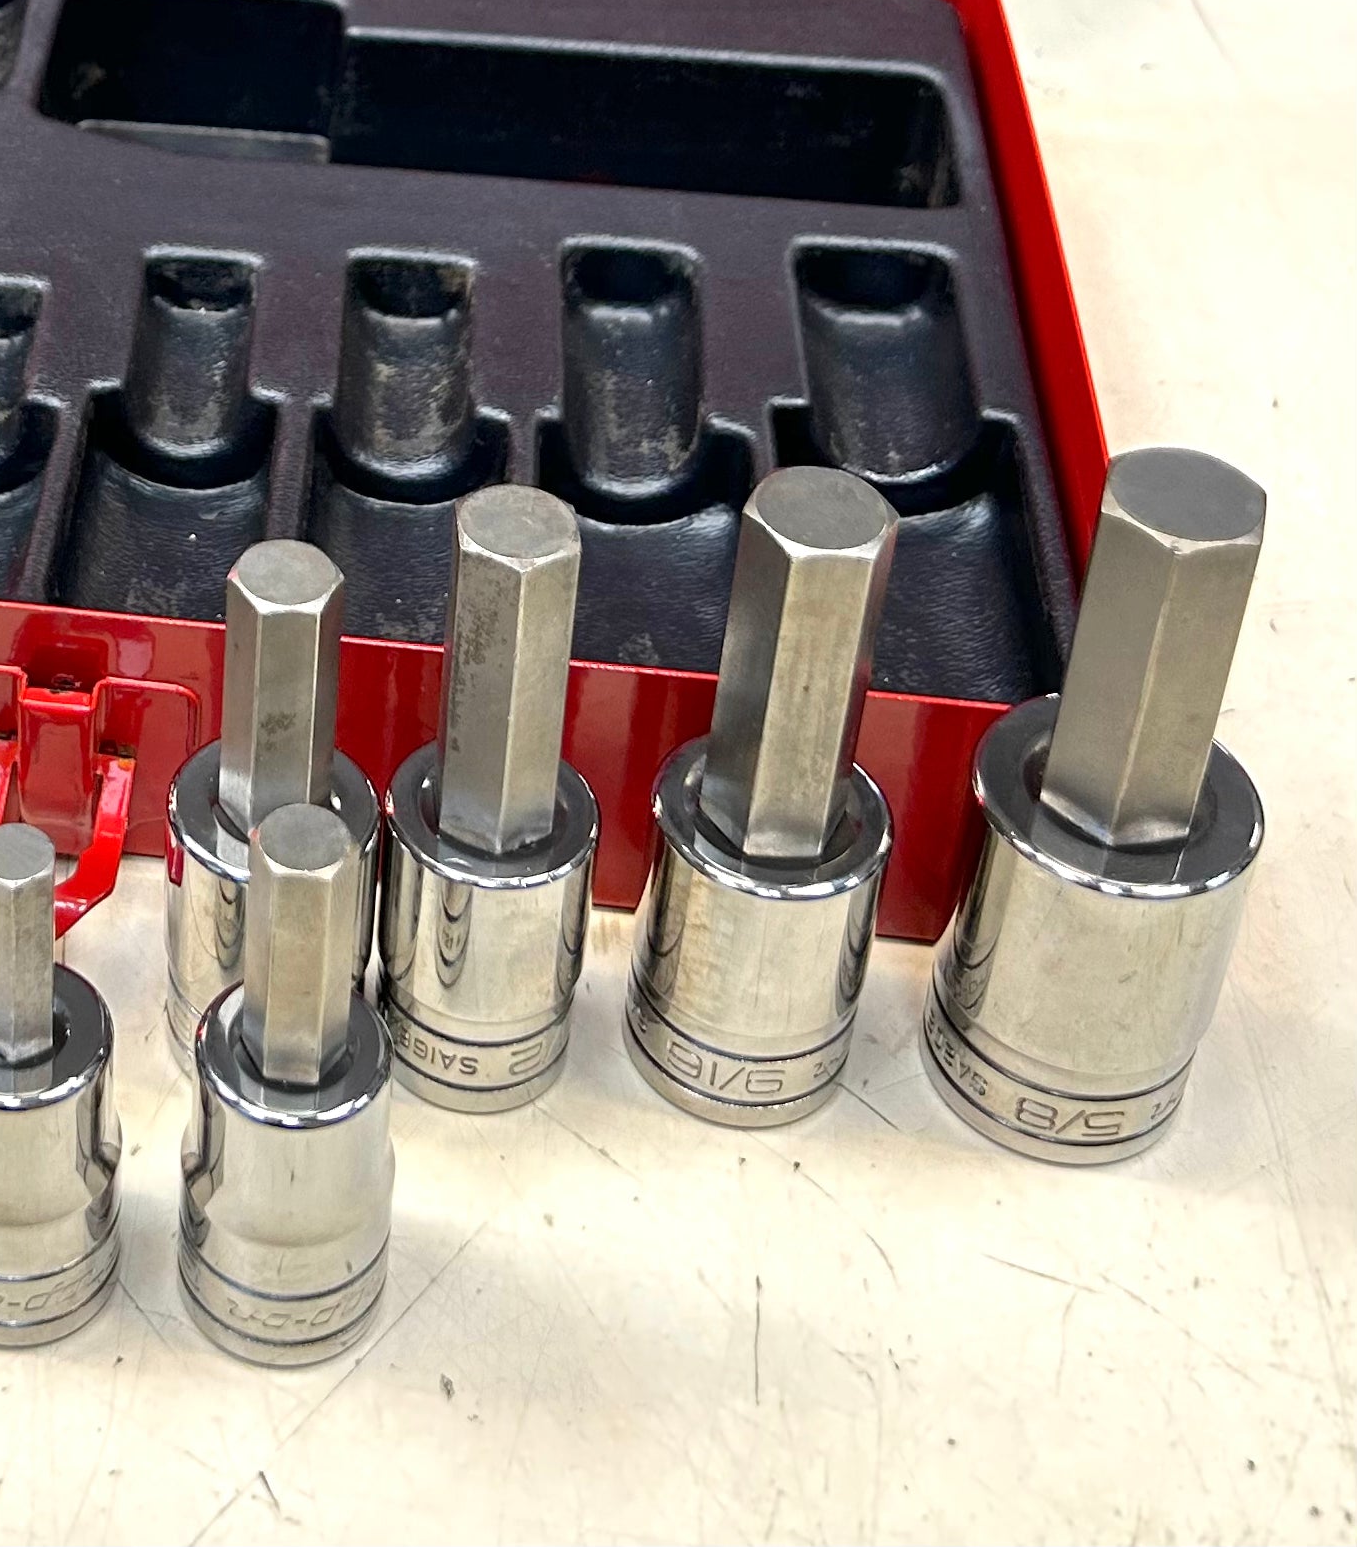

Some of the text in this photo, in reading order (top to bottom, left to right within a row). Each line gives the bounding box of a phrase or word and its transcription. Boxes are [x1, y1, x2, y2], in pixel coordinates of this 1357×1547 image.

[508, 1036, 554, 1076] /2
[666, 1040, 786, 1095] 9/16
[1014, 1096, 1126, 1139] 5/8
